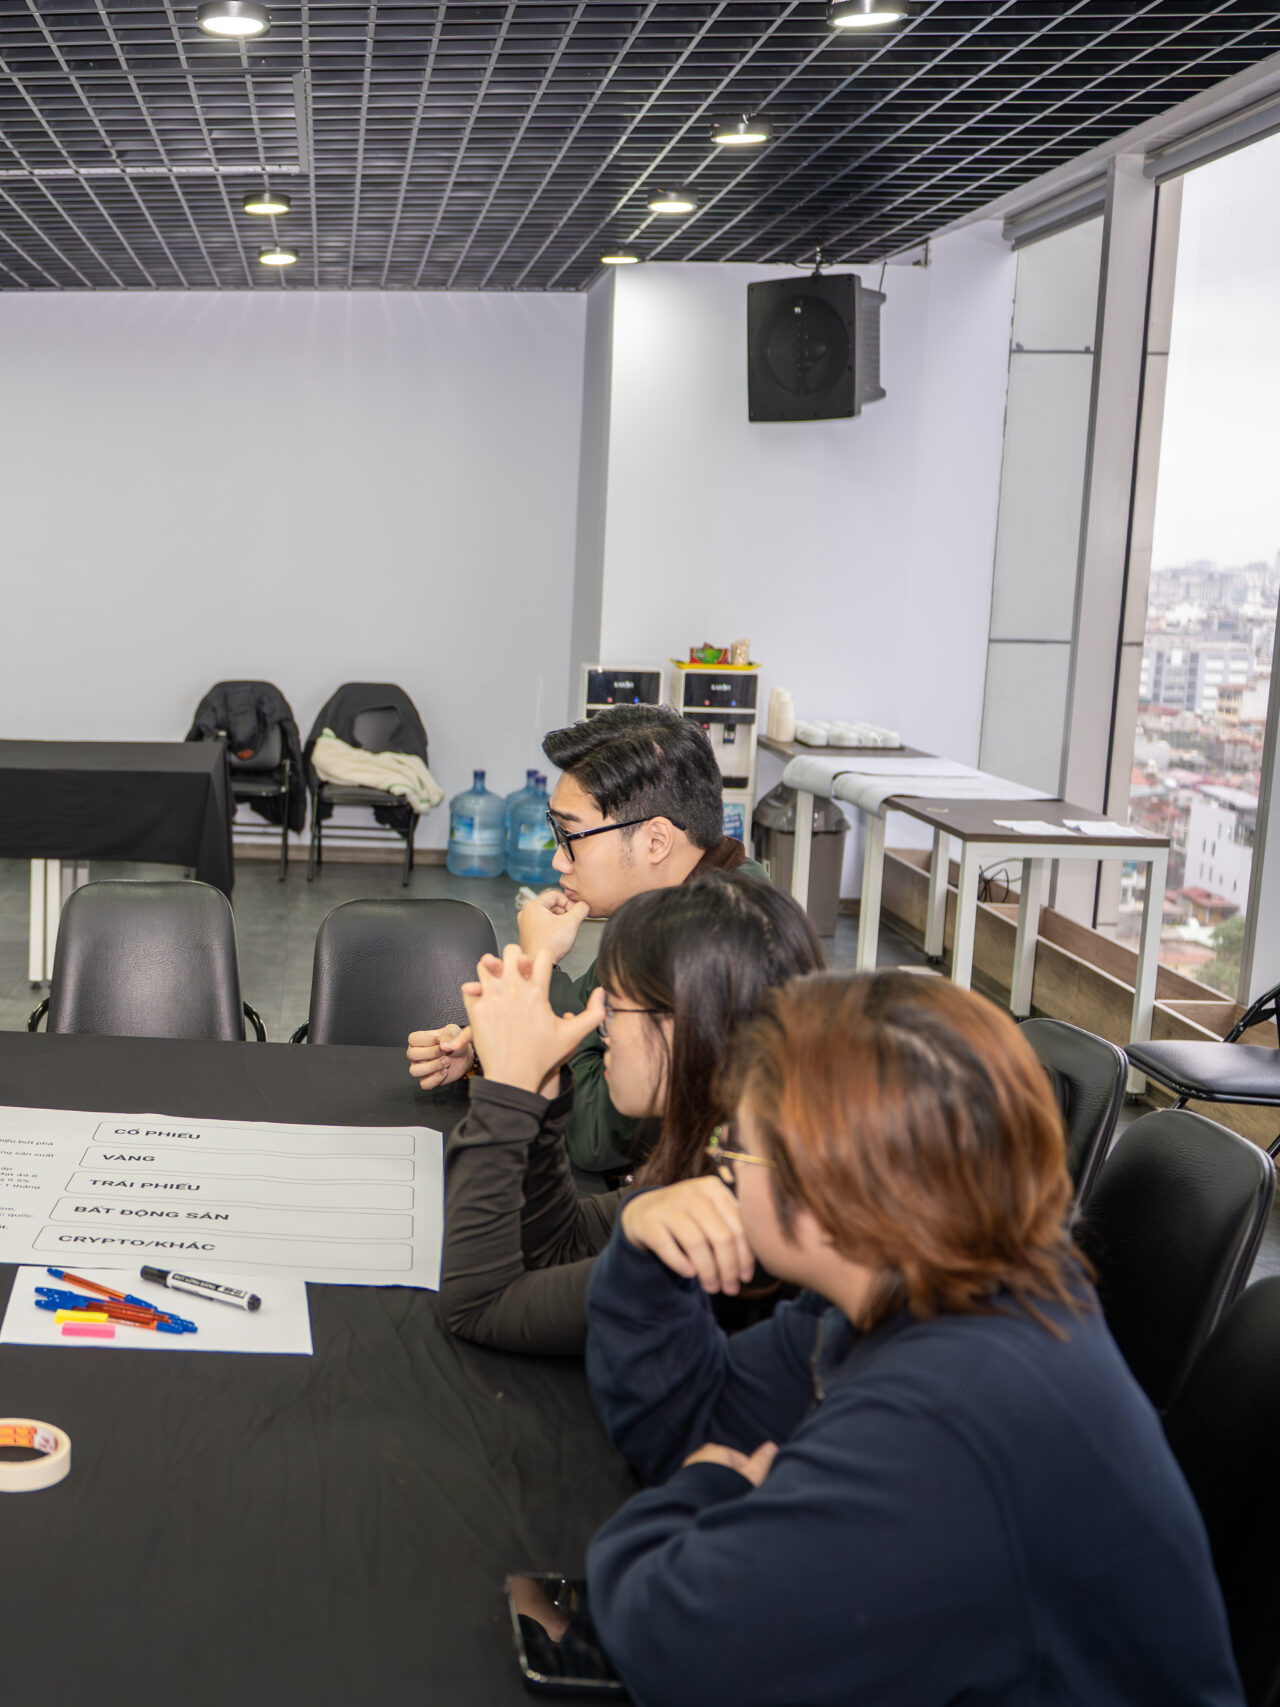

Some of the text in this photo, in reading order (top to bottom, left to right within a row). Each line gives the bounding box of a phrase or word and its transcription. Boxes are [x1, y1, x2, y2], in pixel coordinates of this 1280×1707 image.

[145, 1130, 200, 1139] PHIẾU
[90, 1179, 201, 1191] TRÁI PHIẾU
[74, 1205, 230, 1220] BẤT ĐỘNG SẢN
[58, 1235, 216, 1250] CRYPTO/KHÁC
